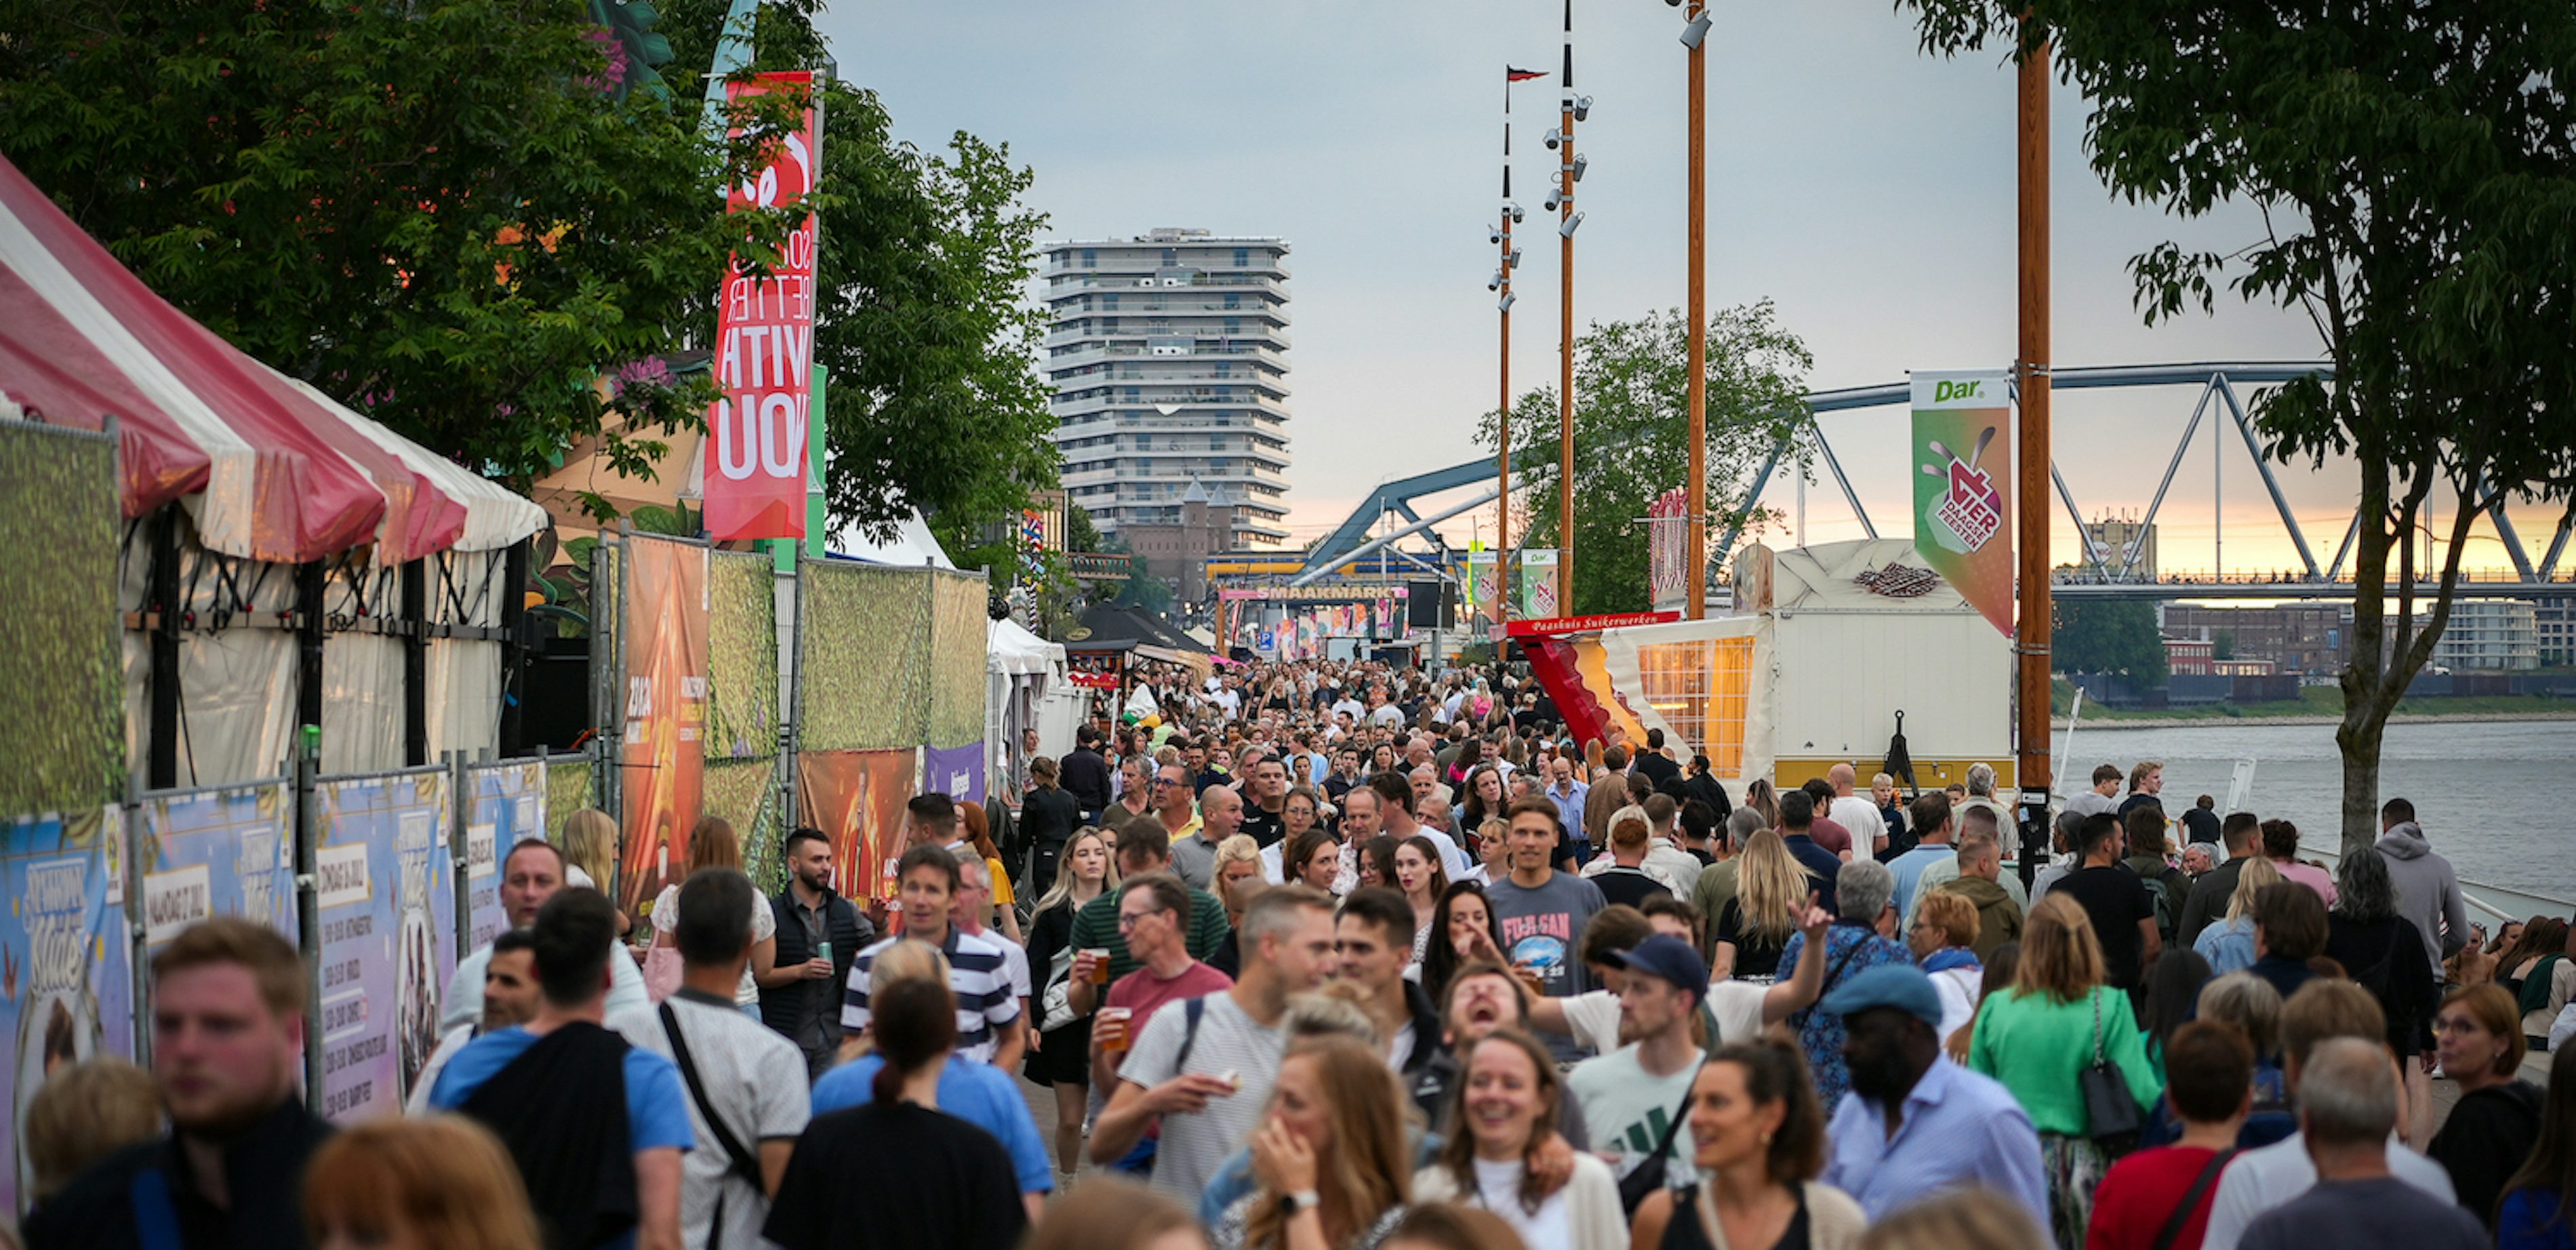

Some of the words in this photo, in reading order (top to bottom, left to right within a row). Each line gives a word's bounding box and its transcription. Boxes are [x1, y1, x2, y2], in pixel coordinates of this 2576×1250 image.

[1935, 380, 1981, 402] Dar
[1939, 509, 1979, 548] FEESTEN
[1946, 501, 1986, 541] DAAGSE
[1256, 586, 1406, 599] SMAAKMARKT
[1583, 613, 1658, 629] Suikerwerken
[1262, 632, 1270, 643] P
[1539, 912, 1571, 942] SAN
